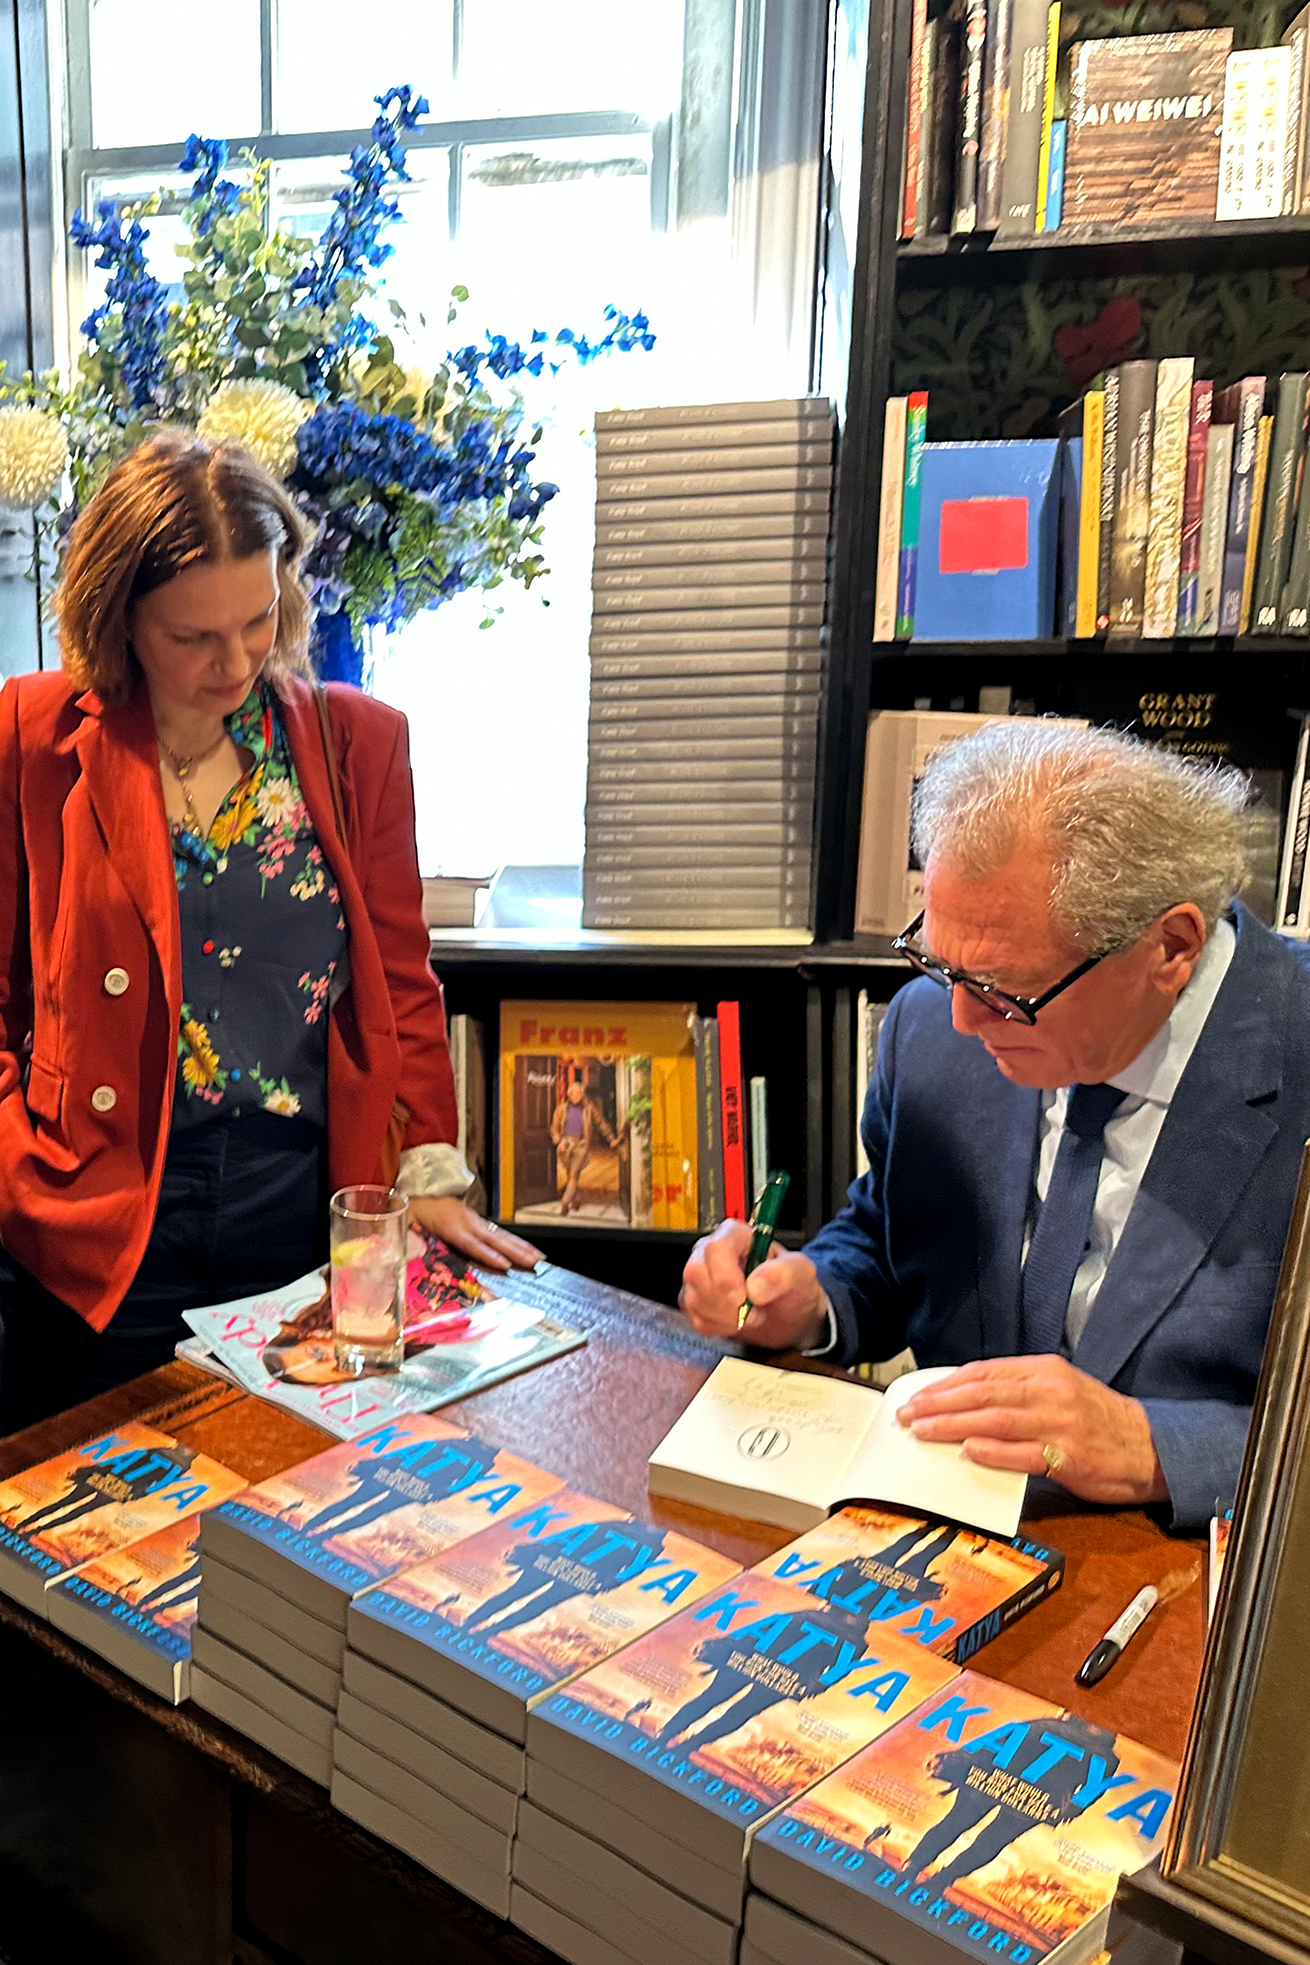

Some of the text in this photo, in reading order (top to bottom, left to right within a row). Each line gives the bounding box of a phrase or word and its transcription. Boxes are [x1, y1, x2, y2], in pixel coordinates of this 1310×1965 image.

[1113, 94, 1213, 124] WEIWEI
[1138, 692, 1217, 711] GRANT
[1141, 709, 1212, 728] WOOD
[519, 1019, 629, 1046] Franz
[78, 1434, 210, 1512] KATYA
[355, 1424, 523, 1515] KATYA
[219, 1502, 369, 1587] DAVID BICKFORD
[508, 1505, 699, 1607] KATYA
[64, 1576, 112, 1606] DAVID
[774, 1551, 957, 1646] KATYA
[367, 1592, 544, 1692] DAVID BICKFORD
[694, 1591, 912, 1714] KATYA
[956, 1608, 1001, 1664] KATYA
[551, 1697, 761, 1817] DAVID BICKFORD
[918, 1694, 1173, 1841] KATYA
[777, 1819, 1033, 1965] DAVID BICKFORD
